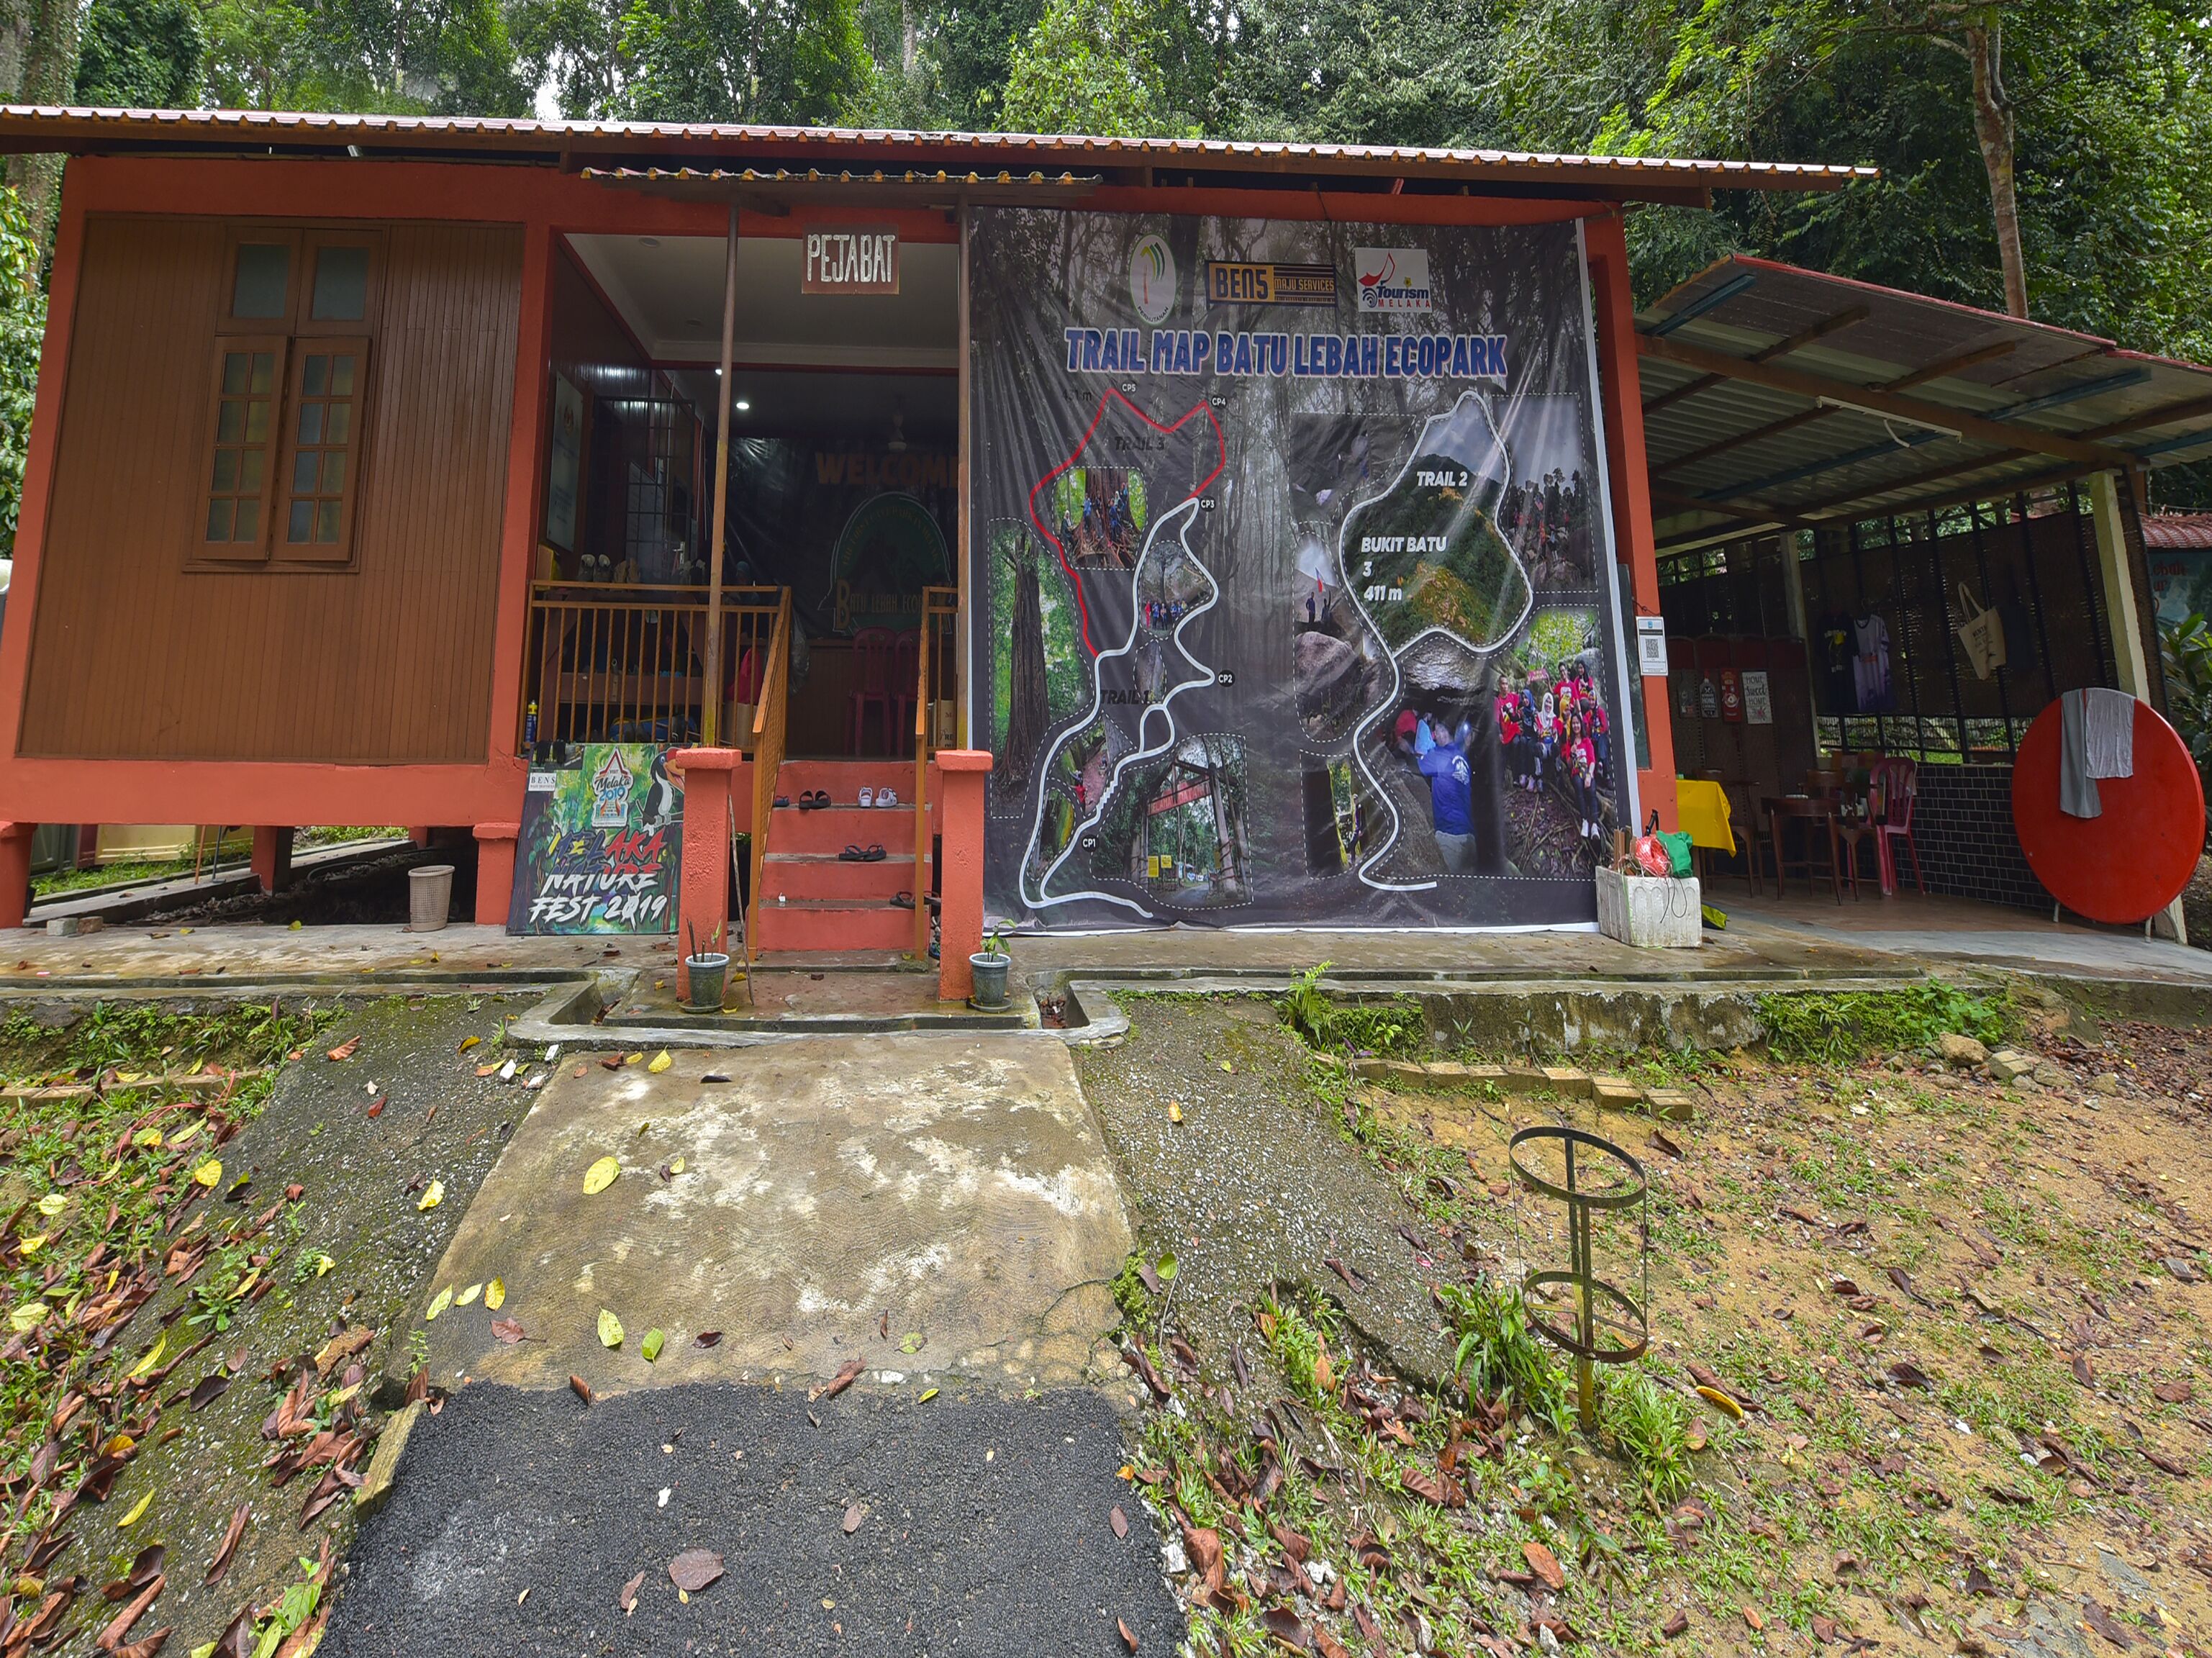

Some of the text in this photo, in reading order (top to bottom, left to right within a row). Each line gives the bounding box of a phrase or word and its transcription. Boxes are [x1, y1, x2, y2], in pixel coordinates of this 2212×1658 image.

[807, 234, 895, 282] PEJABAT
[1274, 278, 1335, 291] MAJU SERVICES
[1377, 286, 1429, 299] Tourism
[1378, 299, 1431, 308] MELAKA
[1138, 305, 1169, 322] PERHUTANAN
[1064, 327, 1508, 379] TRAIL MAP BATU LEBAH ECOPARK
[1122, 384, 1136, 392] CP5
[1212, 397, 1226, 407] CP4
[1115, 436, 1165, 450] TRAIL 3
[1417, 471, 1468, 486] TRAIL 2
[1200, 499, 1215, 509] CP3
[1361, 537, 1447, 553] BUKIT BATU
[1362, 561, 1373, 577] 3
[1364, 585, 1402, 602] 411 m
[1218, 674, 1233, 684] CP2
[1100, 689, 1150, 705] TRAIL 1
[594, 775, 631, 791] Melaka
[599, 787, 625, 801] 2019
[546, 827, 668, 864] MELAKA
[1082, 838, 1097, 848] CP1
[540, 863, 663, 897] NATURE
[529, 891, 668, 932] FEST 2019
